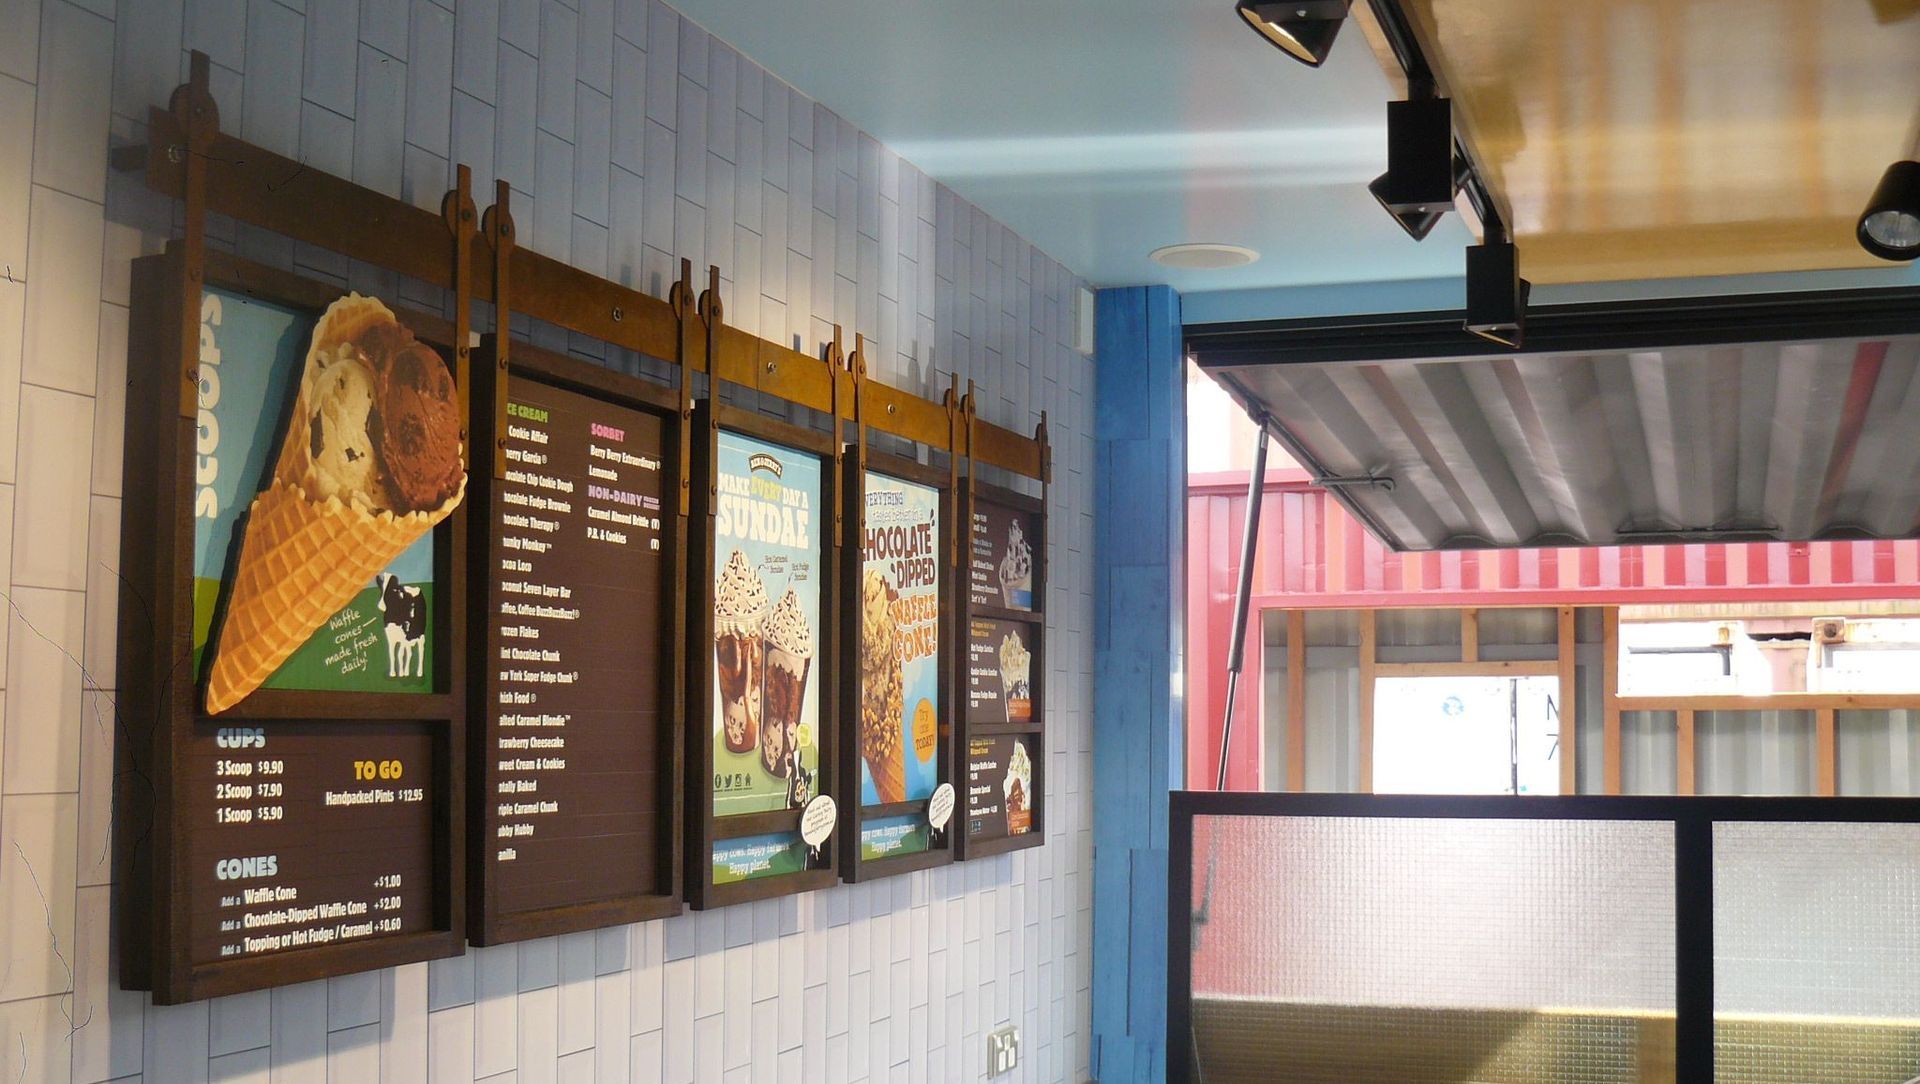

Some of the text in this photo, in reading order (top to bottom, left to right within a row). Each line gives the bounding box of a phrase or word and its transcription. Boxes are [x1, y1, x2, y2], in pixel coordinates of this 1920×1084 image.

[195, 294, 222, 519] SCOOPS
[507, 403, 549, 423] CE CREAM
[508, 425, 530, 440] Cookie
[591, 422, 625, 442] SORBET
[506, 448, 521, 462] erry
[590, 444, 606, 460] Berry
[606, 448, 621, 463] Berry
[589, 464, 618, 481] Lemonade
[539, 475, 556, 489] Cookie
[557, 478, 574, 493] Dough
[718, 472, 809, 509] MAKE EVERY DAY A
[529, 495, 547, 510] Fudge
[547, 498, 571, 513] Brownie
[588, 484, 643, 507] NON-DAIRY
[866, 491, 904, 506] VERYTHING
[587, 506, 611, 521] Caramel
[611, 510, 632, 525] Almond
[718, 494, 809, 549] SUNDAE
[605, 530, 627, 545] Cookies
[863, 523, 932, 562] HOCOLATE
[517, 559, 532, 572] Loco
[897, 557, 936, 589] DIPPED
[523, 582, 541, 595] Seven
[543, 584, 560, 598] Layer
[560, 586, 571, 599] Bar
[330, 608, 361, 630] Waffle
[518, 603, 536, 617] Coffee
[890, 594, 937, 626] WAFFLE
[335, 625, 362, 644] cones
[501, 626, 539, 639] rozen Flakes
[325, 632, 378, 666] made fresh
[893, 622, 937, 663] CONE!
[341, 651, 368, 674] daily!
[511, 647, 541, 661] Chocolate
[542, 649, 560, 662] Chunk
[500, 671, 509, 681] ew
[509, 669, 522, 681] York
[523, 670, 539, 683] Super
[540, 671, 556, 683] Fudge
[500, 691, 513, 704] hish
[514, 692, 530, 704] Food
[499, 714, 515, 726] alted
[516, 714, 541, 726] Caramel
[216, 727, 267, 749] CUPS
[499, 736, 565, 750] trawberry Cheesecake
[217, 759, 284, 777] 3 Scoop $9.90
[354, 760, 403, 780] TO GO
[498, 759, 515, 771] weet
[516, 758, 535, 770] Cream
[542, 757, 566, 770] Cookies
[217, 783, 283, 799] 2 Scoop $7.90
[498, 779, 537, 794] otally Baked
[325, 788, 423, 806] Handpacked Pints $12.95
[217, 806, 283, 823] 1 Scoop $5.90
[498, 800, 559, 816] riple Caramel Chunk
[498, 823, 535, 838] ubby Hubby
[497, 848, 517, 861] anilla
[216, 855, 278, 880] CONES
[221, 896, 234, 907] Add
[244, 887, 274, 905] Waffle
[275, 886, 297, 901] Cone
[373, 874, 402, 889] +$1.00
[221, 920, 234, 932] Add
[244, 905, 319, 928] Chocolate-Dipped
[319, 902, 347, 917] Waffle
[347, 901, 367, 915] Cone
[373, 896, 402, 910] +$2.00
[221, 945, 234, 956] Add
[244, 934, 280, 953] Topping
[281, 935, 291, 947] or
[292, 930, 308, 946] Hot
[308, 927, 334, 944] Fudge
[340, 921, 373, 938] Caramel
